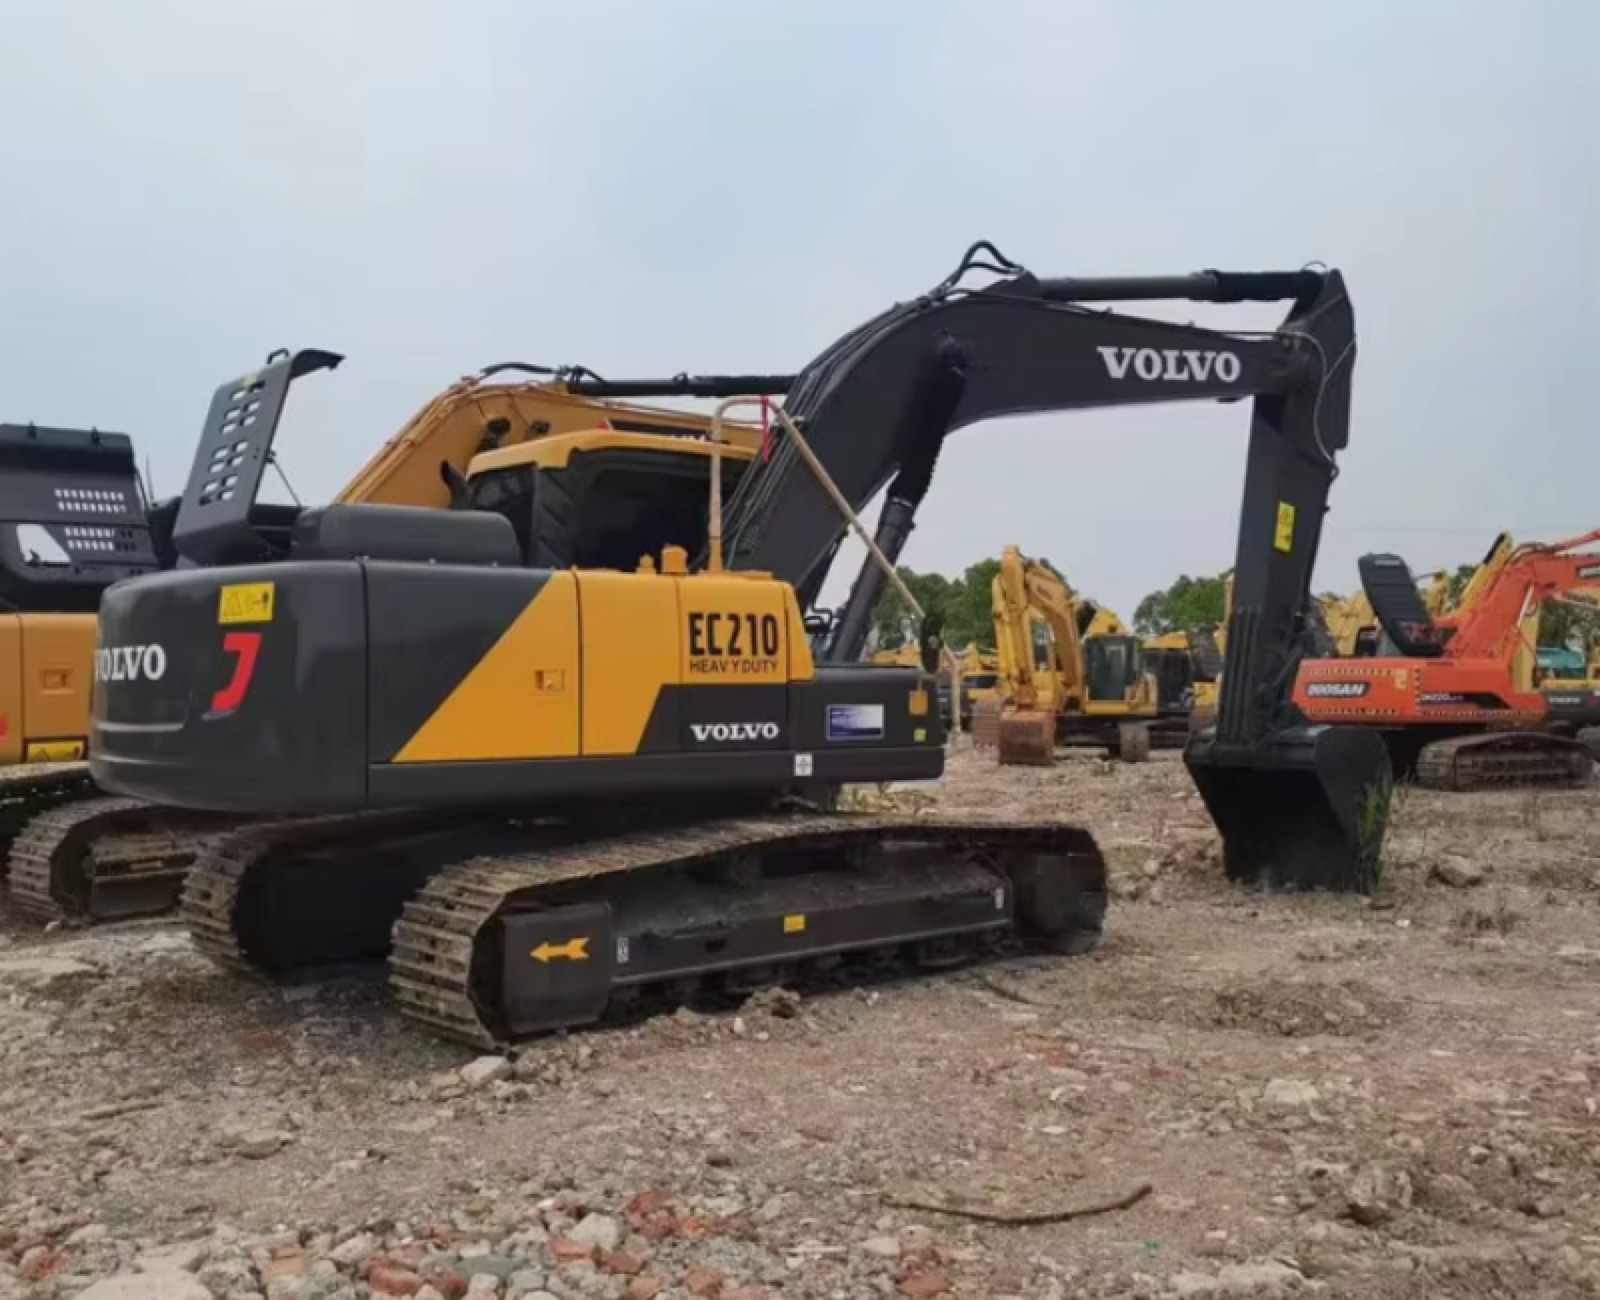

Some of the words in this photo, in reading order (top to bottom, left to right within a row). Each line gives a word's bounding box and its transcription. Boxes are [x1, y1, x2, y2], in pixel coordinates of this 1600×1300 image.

[1096, 345, 1241, 382] VOLVO
[688, 613, 779, 656] EC210
[691, 721, 780, 741] VOLVO
